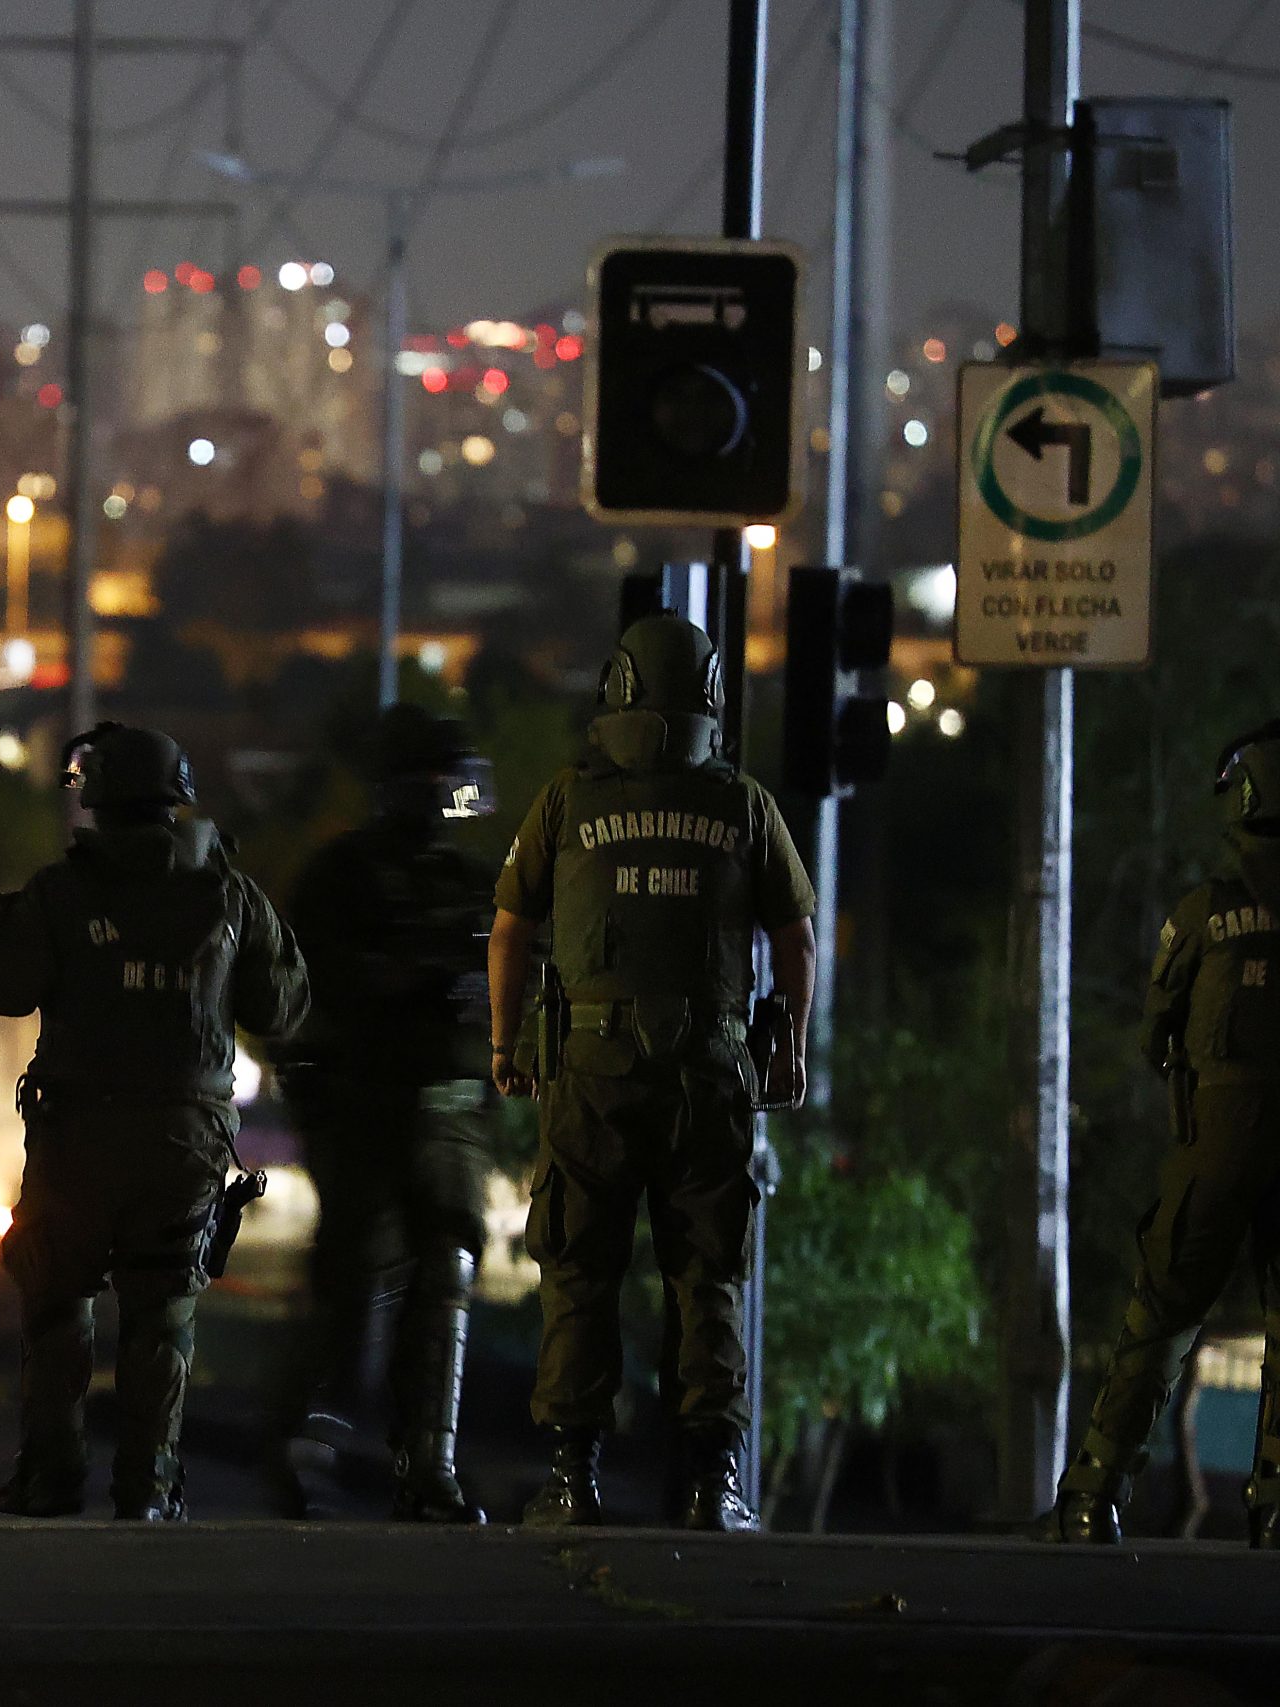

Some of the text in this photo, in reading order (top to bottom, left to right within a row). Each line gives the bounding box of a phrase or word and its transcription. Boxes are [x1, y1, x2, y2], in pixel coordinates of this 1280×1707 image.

[1055, 559, 1116, 582] SOLO
[1035, 594, 1122, 618] FLECHA
[1016, 630, 1088, 654] VERDE
[578, 809, 740, 851] CARABINEROS
[616, 866, 700, 896] DE CHILE
